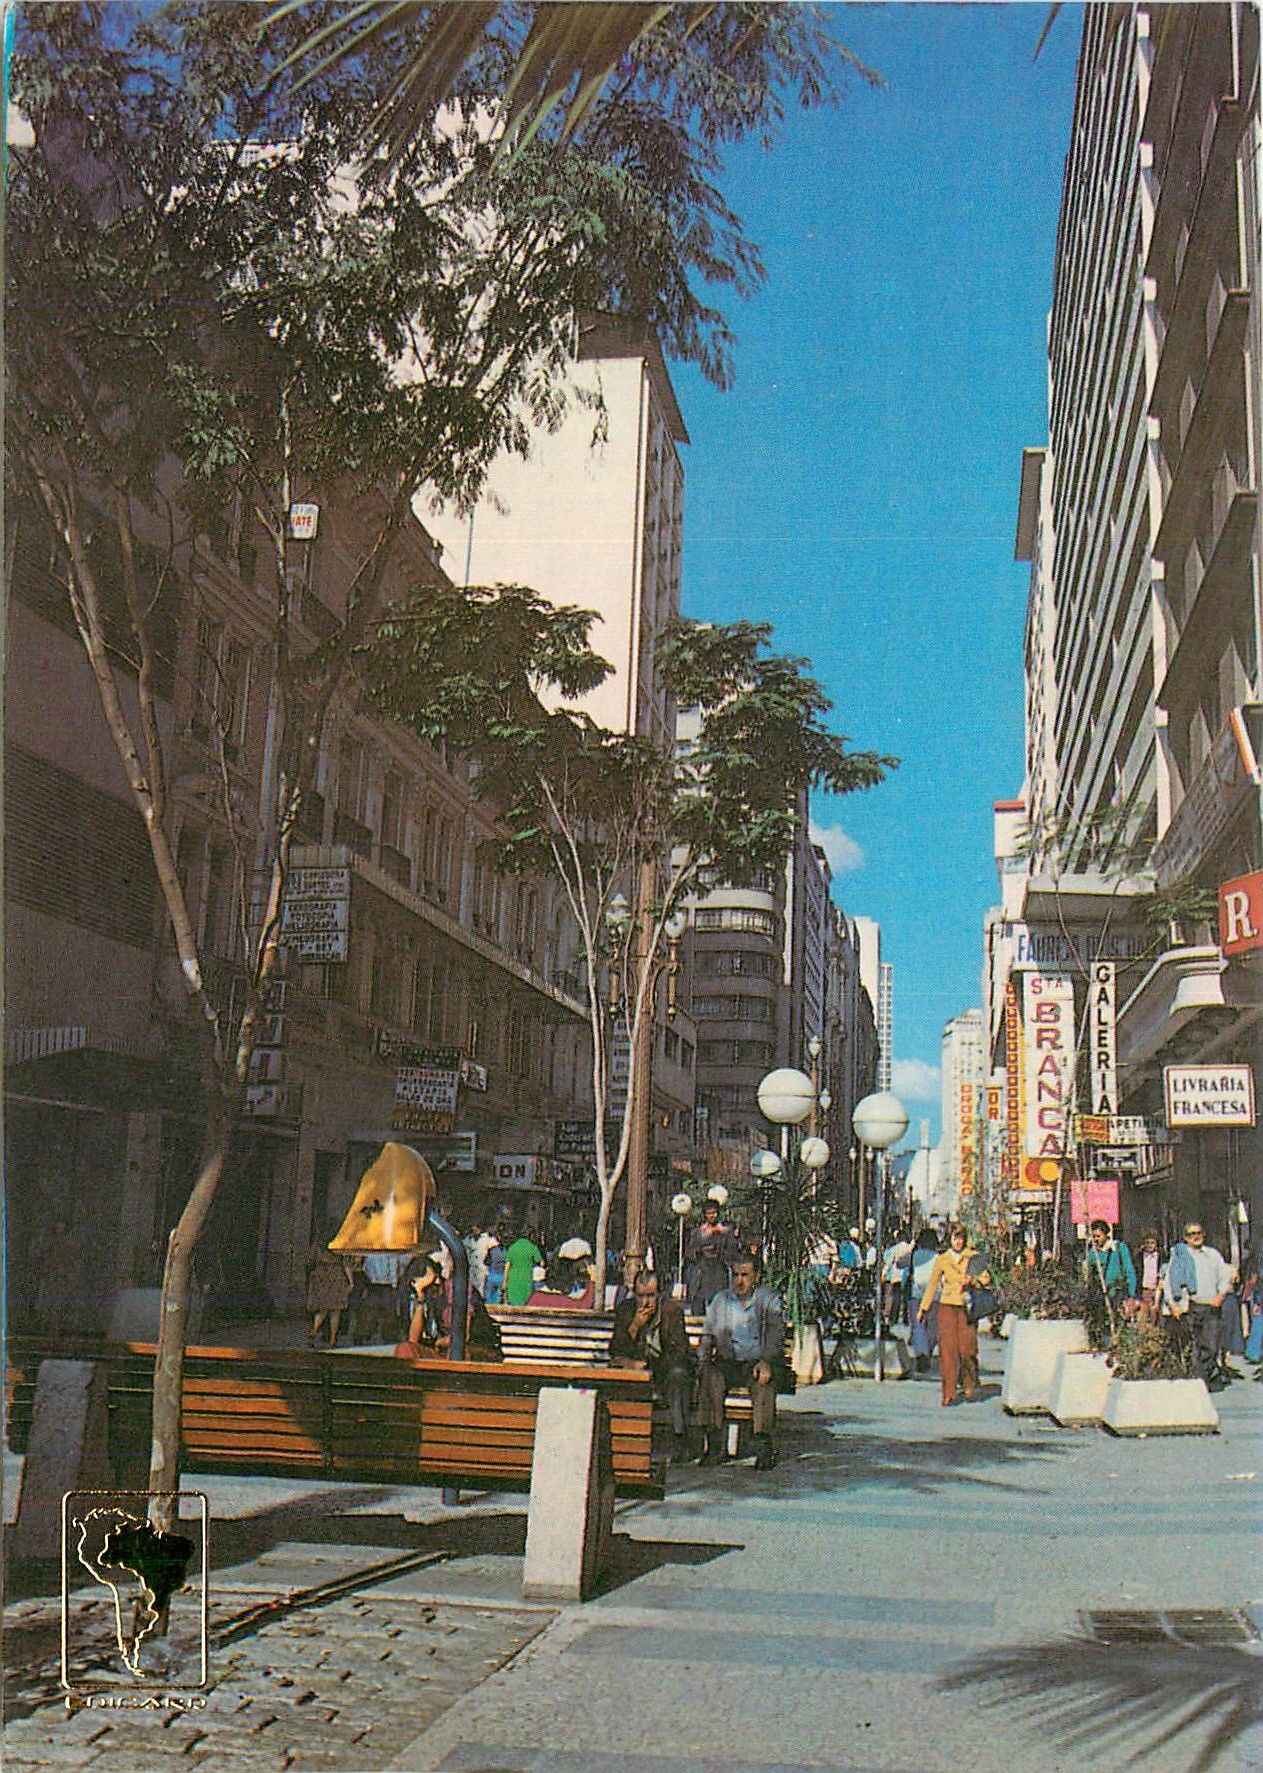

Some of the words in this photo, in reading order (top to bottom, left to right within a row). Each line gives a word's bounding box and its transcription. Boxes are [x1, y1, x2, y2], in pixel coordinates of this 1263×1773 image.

[1035, 1002, 1064, 1157] BRANCA
[1095, 964, 1113, 1113] GALERIA
[1173, 1076, 1244, 1093] LIVRARIA
[1173, 1100, 1247, 1115] FRANCESA
